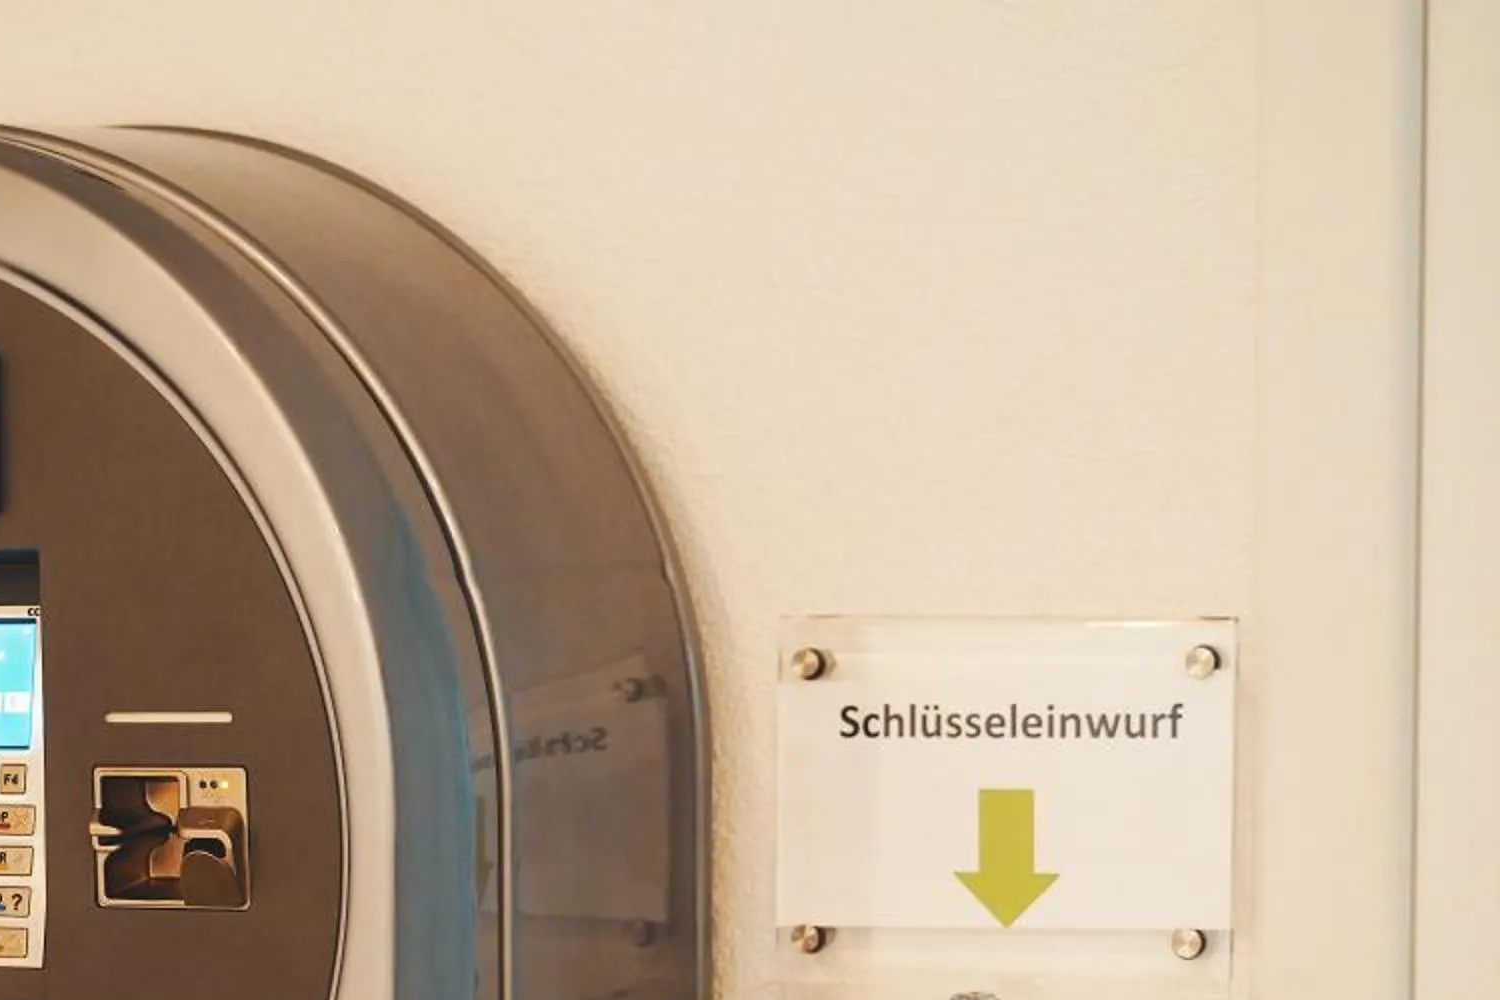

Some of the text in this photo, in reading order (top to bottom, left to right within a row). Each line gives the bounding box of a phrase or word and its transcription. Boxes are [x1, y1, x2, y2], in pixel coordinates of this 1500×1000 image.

[839, 703, 1184, 739] Schlüsseleinwurf
[3, 772, 19, 785] F4
[11, 893, 23, 911] ?
